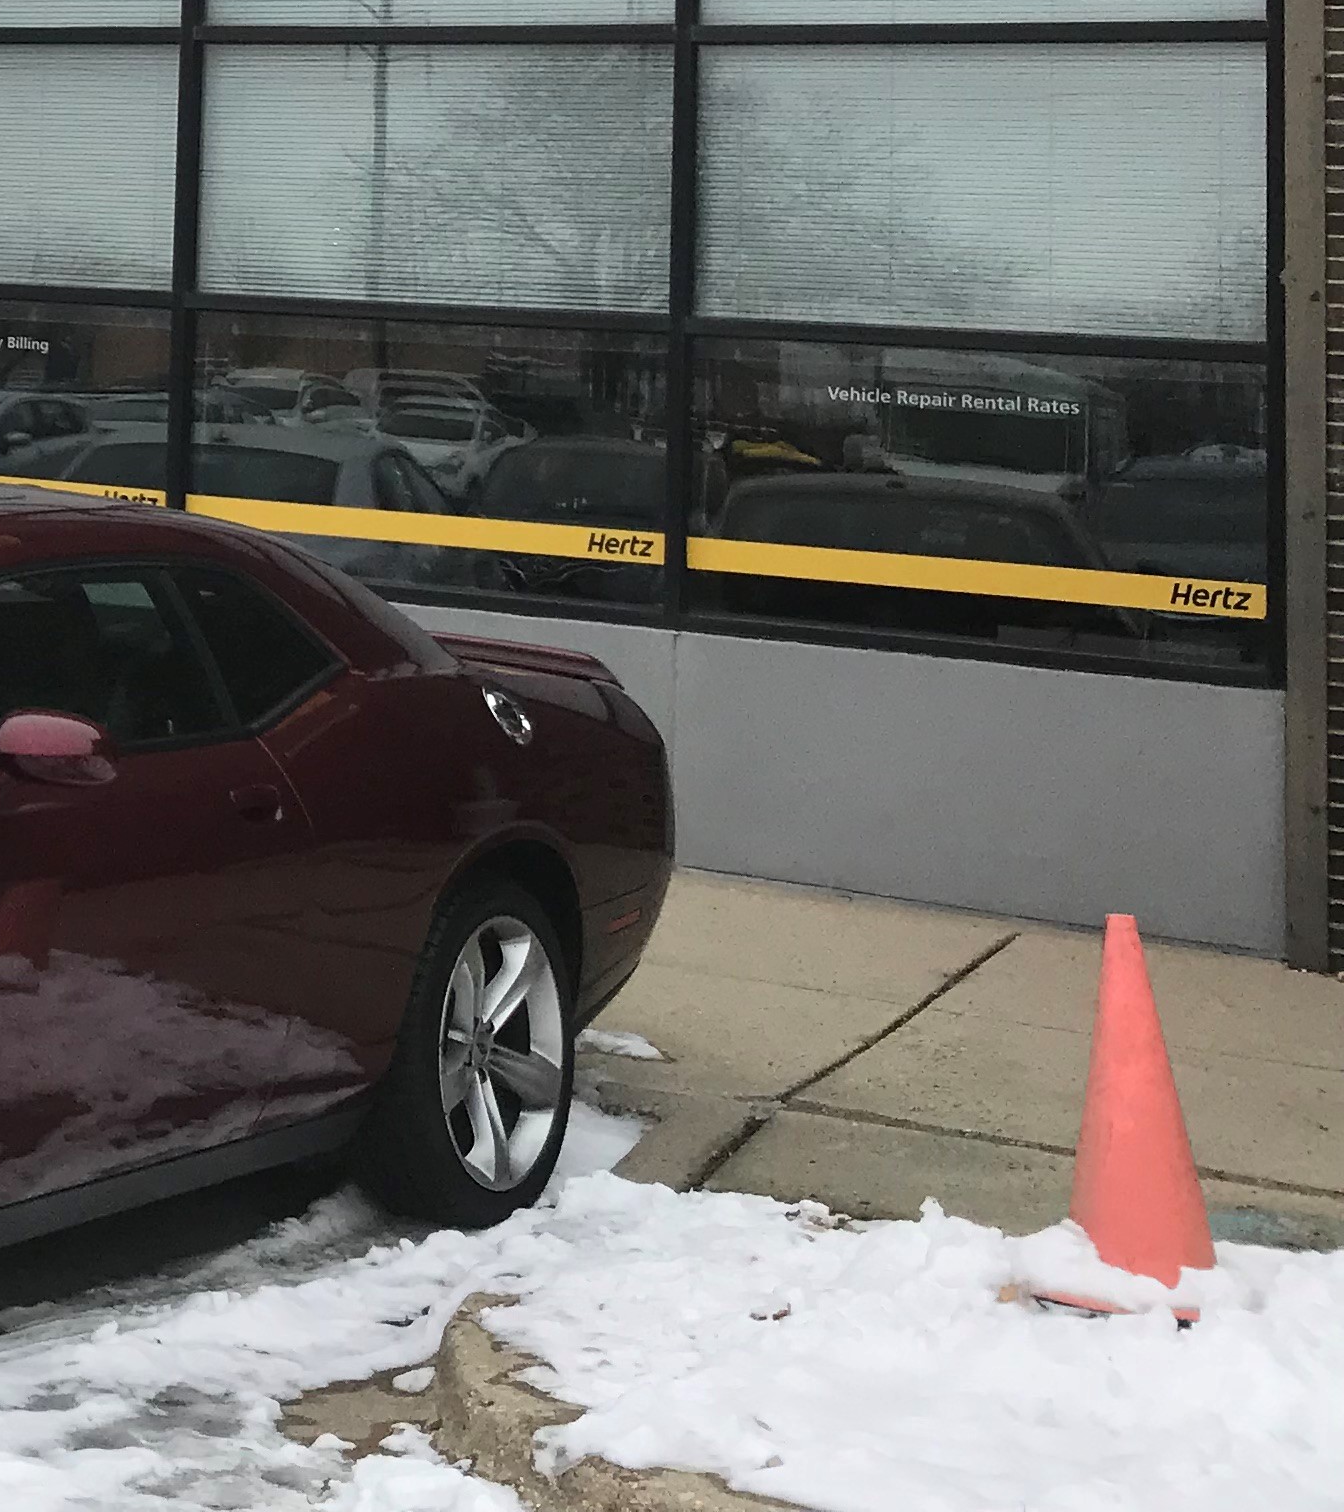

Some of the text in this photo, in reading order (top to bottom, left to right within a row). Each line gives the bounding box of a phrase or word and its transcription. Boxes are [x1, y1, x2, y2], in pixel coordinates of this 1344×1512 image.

[7, 336, 50, 354] Billing
[827, 385, 1081, 416] Vehicle Repair Rental Rates
[587, 532, 655, 557] Hertz
[1170, 582, 1252, 611] Hertz
